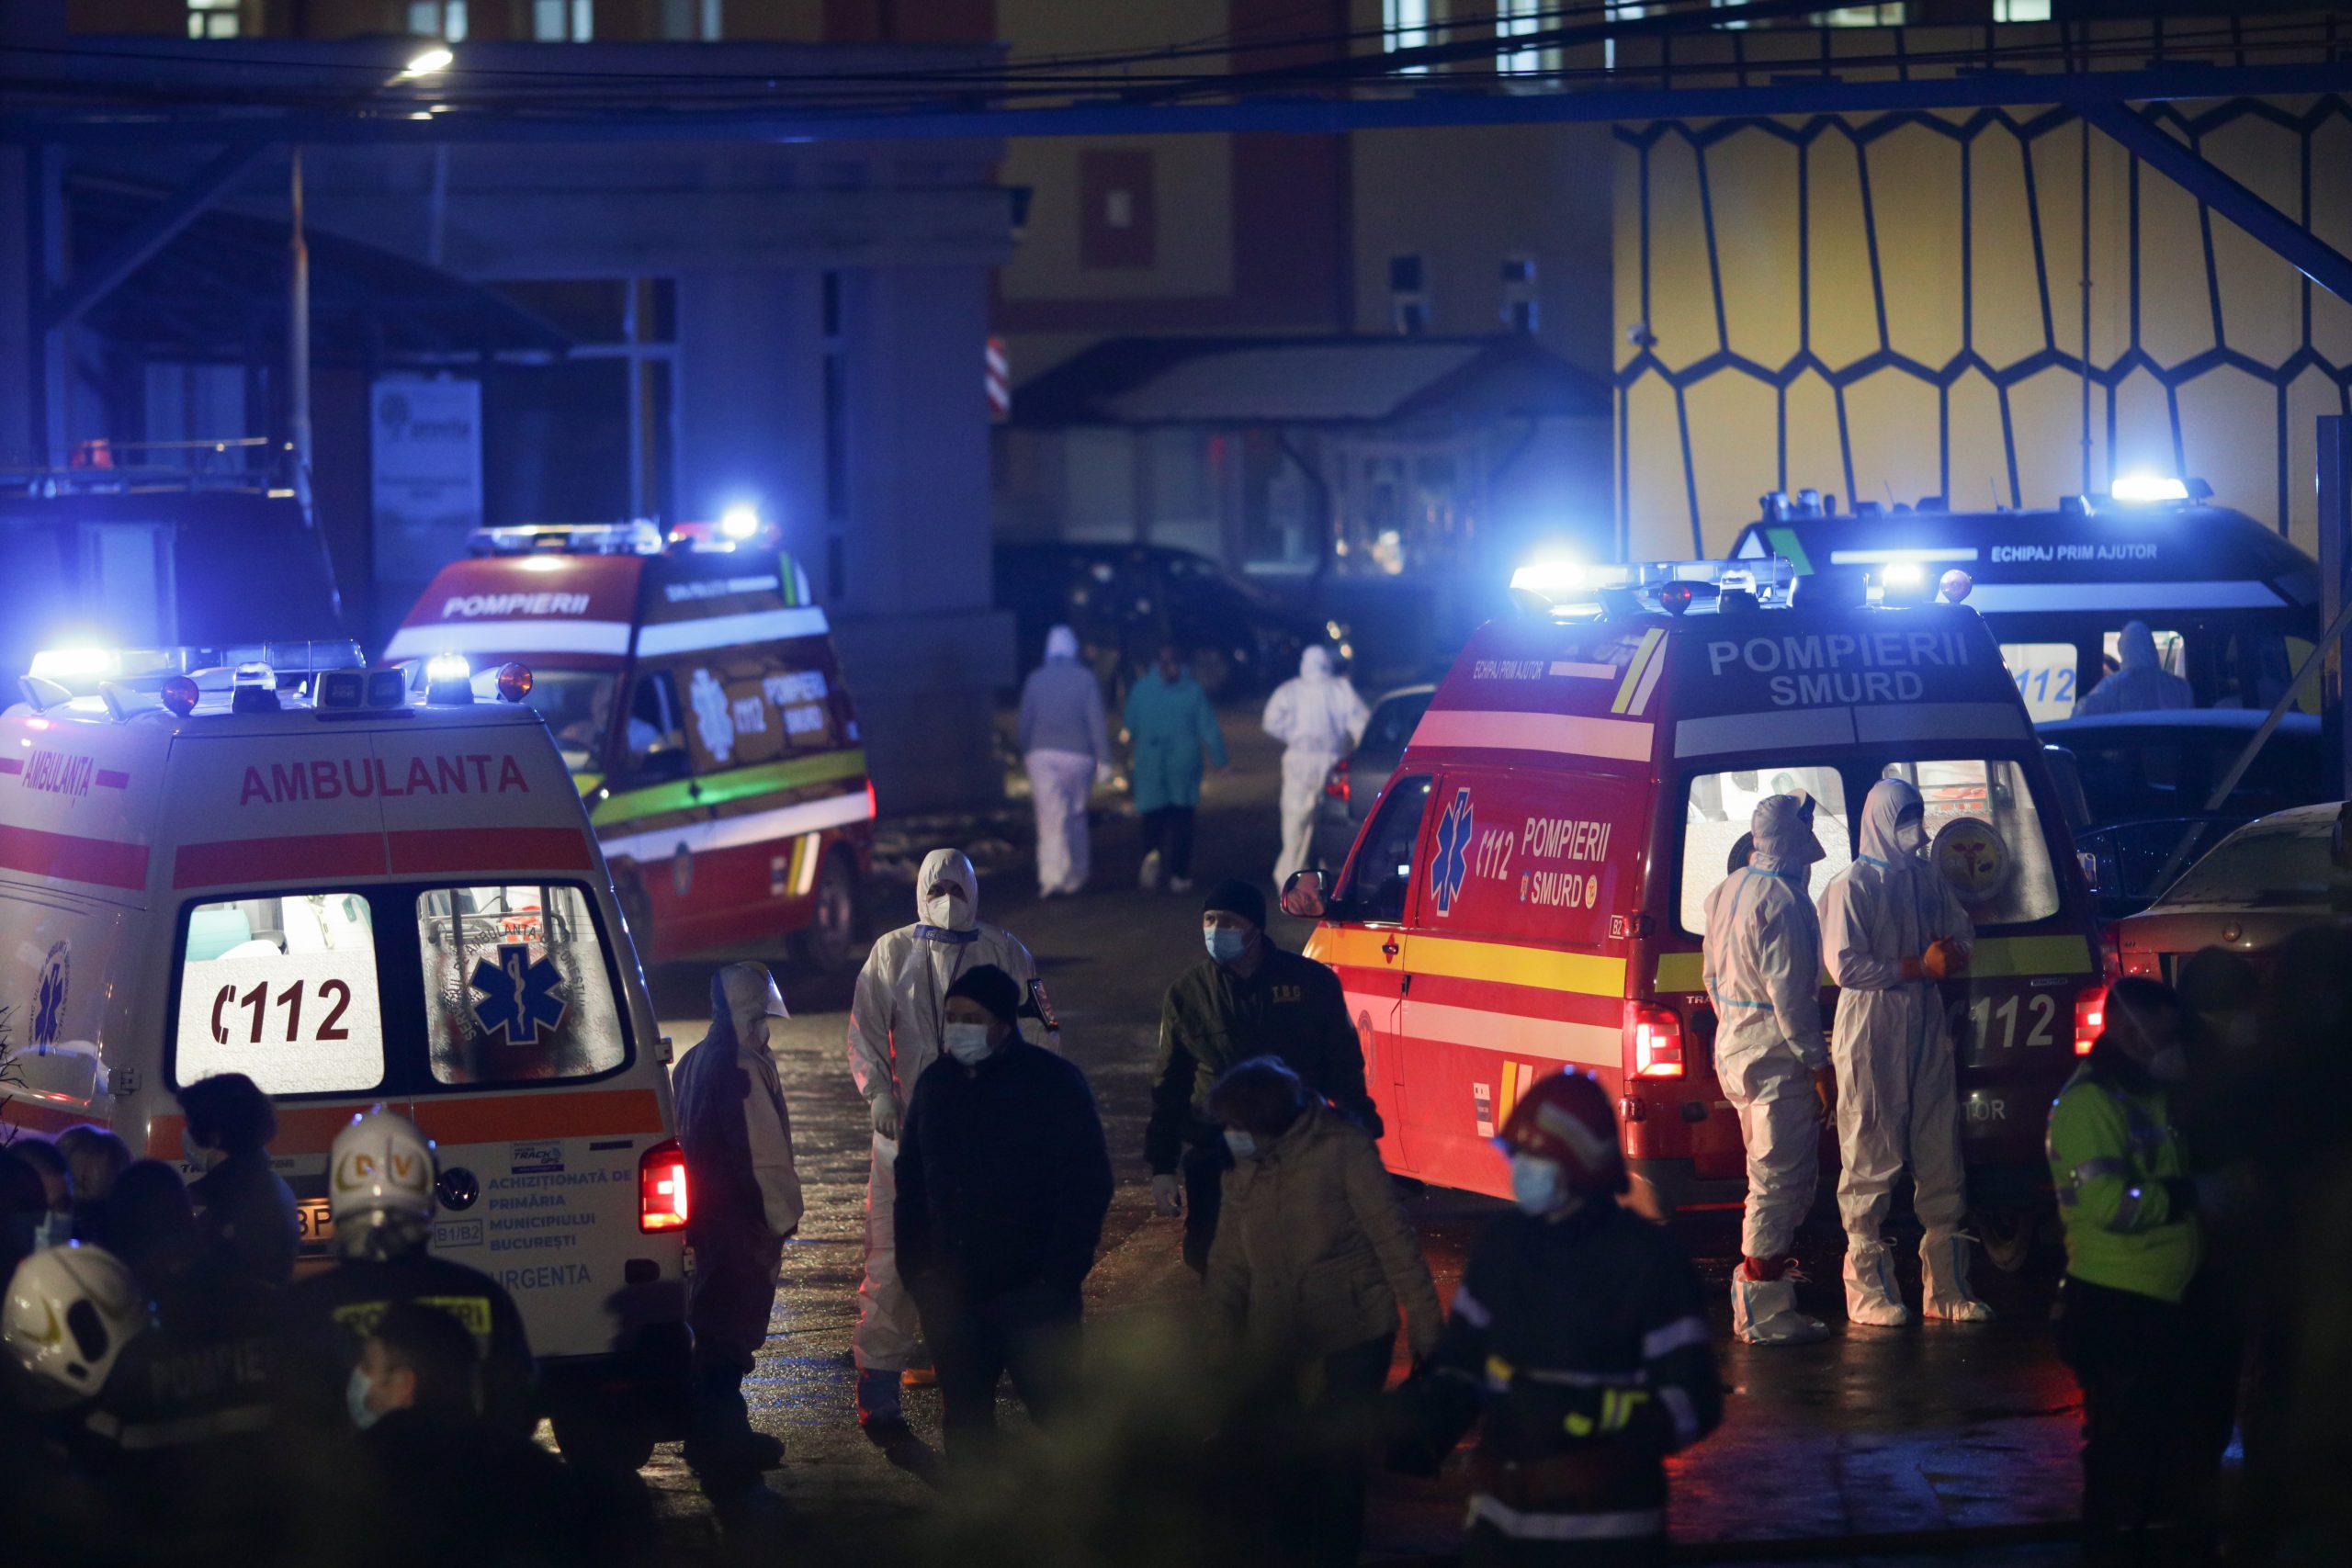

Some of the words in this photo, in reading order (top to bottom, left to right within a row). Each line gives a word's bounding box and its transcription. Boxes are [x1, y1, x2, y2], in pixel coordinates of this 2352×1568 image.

[1991, 546, 2053, 562] ECHIPAJ
[2057, 544, 2094, 560] PRIM
[2097, 543, 2157, 559] AJUTOR
[442, 593, 590, 618] POMPIERII
[1708, 632, 1969, 676] POMPIERII
[1770, 671, 1924, 705] SMURD
[2015, 669, 2076, 702] 112
[240, 755, 530, 806] AMBULANTA
[1483, 829, 1514, 881] 112
[1521, 818, 1611, 862] POMPIERII
[1531, 871, 1583, 908] SMURD
[1612, 919, 1623, 935] B2
[241, 979, 351, 1043] 112
[1969, 994, 2055, 1049] 112
[514, 1150, 551, 1160] TRACK
[612, 1170, 633, 1182] DE
[489, 1194, 567, 1211] PRIMĂRIA
[437, 1225, 480, 1242] B1/B2
[490, 1213, 596, 1231] MUNICIPIULUI
